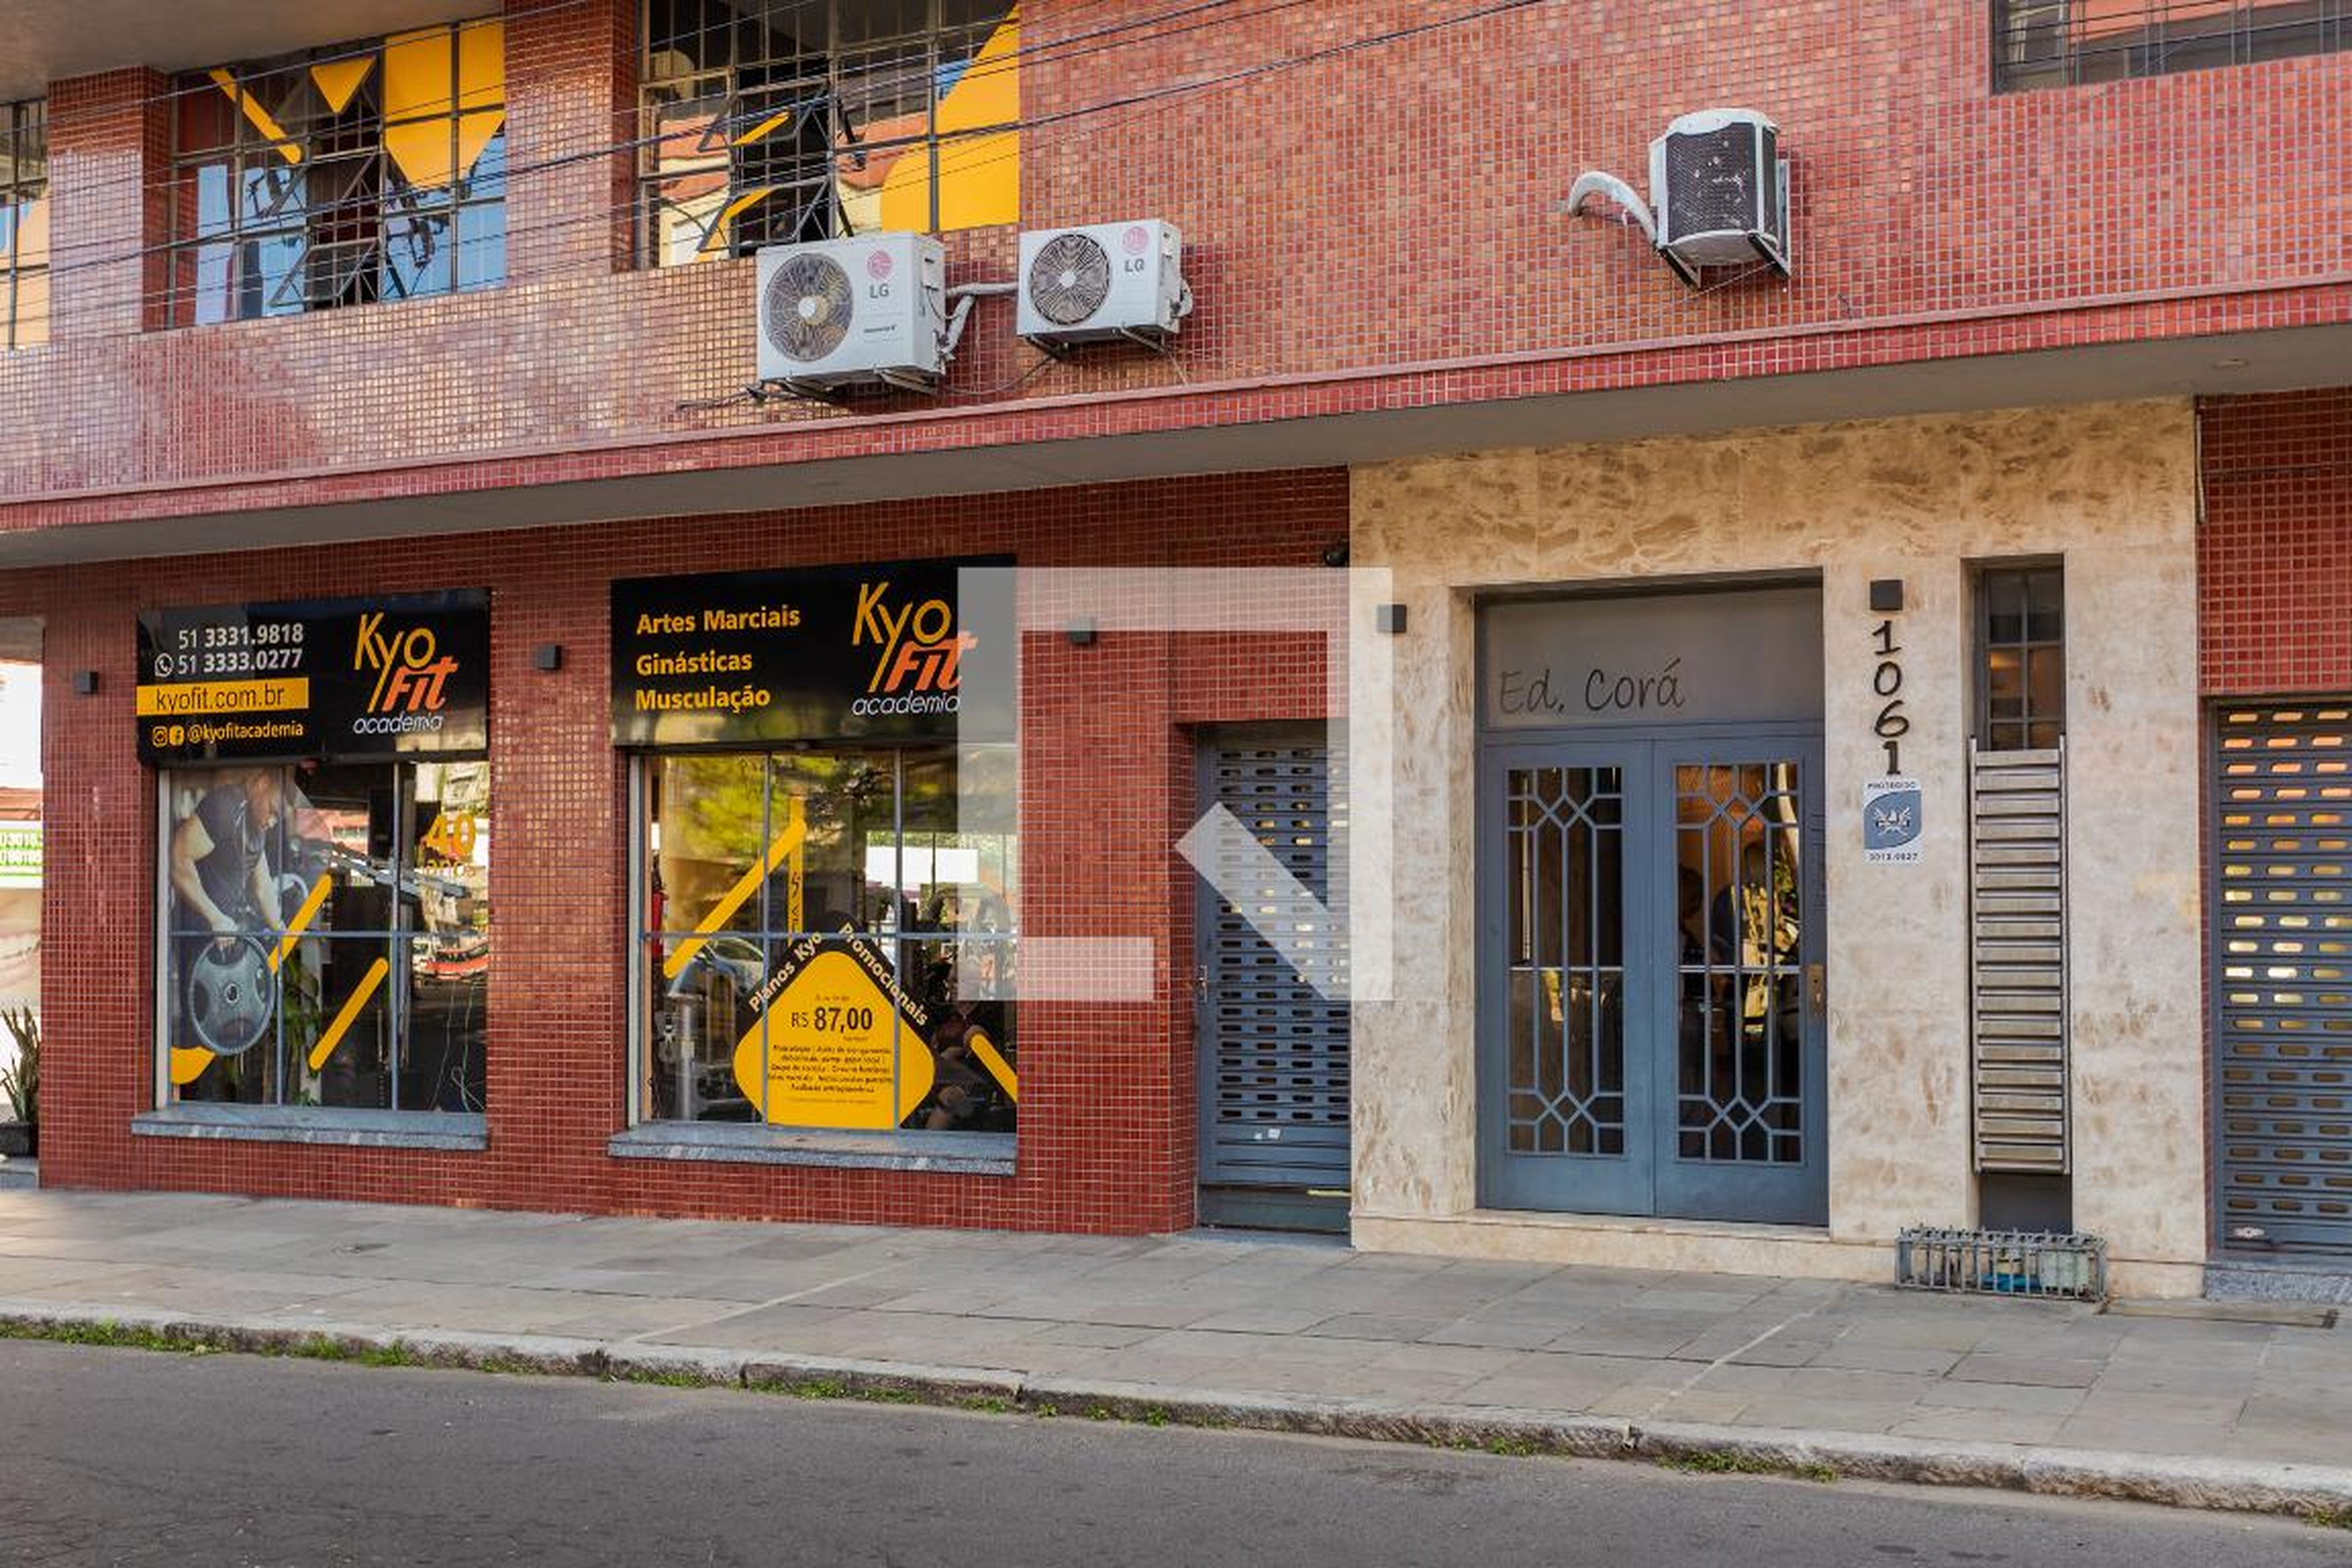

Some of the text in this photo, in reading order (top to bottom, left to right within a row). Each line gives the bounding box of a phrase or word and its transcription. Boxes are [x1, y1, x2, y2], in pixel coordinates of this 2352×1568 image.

[1124, 258, 1144, 273] LG
[869, 283, 889, 299] LG
[636, 604, 801, 635] Artes Marciais
[178, 623, 304, 649] 51 3331.9818
[853, 582, 951, 692] Kyo
[178, 649, 303, 674] 51 3333.0277
[354, 612, 435, 714] Kyo
[636, 647, 753, 676] Ginásticas
[884, 631, 979, 692] Fit
[156, 684, 285, 712] kyofit.com.br
[382, 656, 458, 712] Fit
[636, 684, 771, 712] Musculação
[1585, 658, 1686, 711] Corá
[1871, 621, 1910, 775] 1061
[852, 690, 960, 715] academia
[187, 720, 304, 744] @kyofitacademia
[353, 712, 445, 734] academia
[424, 812, 476, 856] 40
[748, 922, 929, 1027] Planos Kyo Promocionais
[814, 1006, 873, 1033] 87,00
